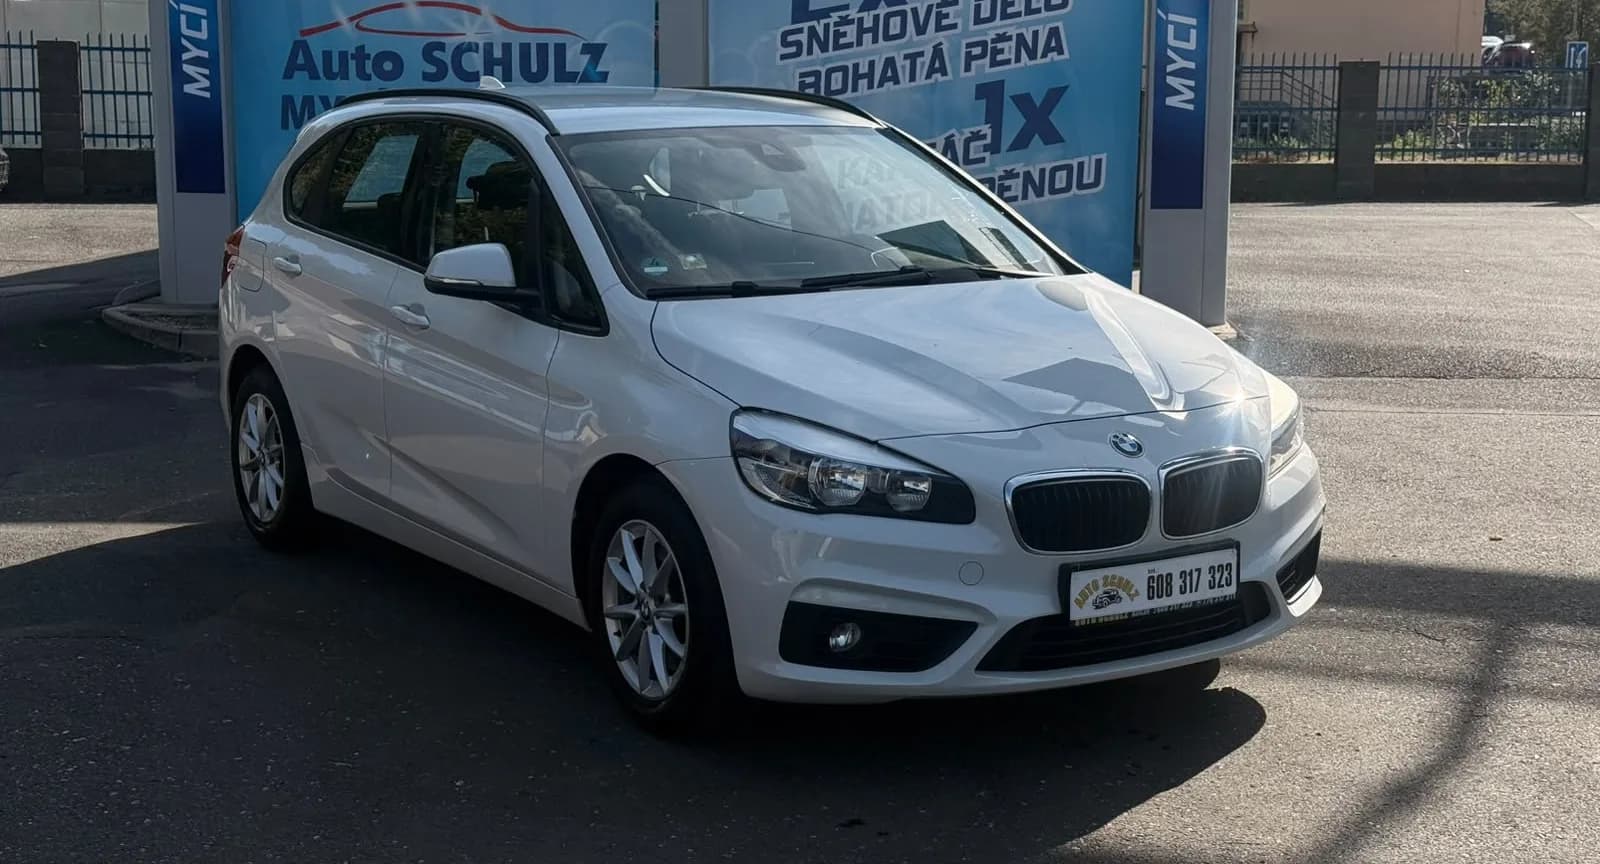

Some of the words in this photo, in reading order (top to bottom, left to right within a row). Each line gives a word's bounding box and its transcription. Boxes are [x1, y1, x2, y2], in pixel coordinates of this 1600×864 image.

[169, 0, 211, 98] MYCÍ
[282, 39, 405, 81] Auto
[422, 41, 609, 83] SCHULZ
[964, 25, 1066, 73] PĚNA
[1157, 8, 1197, 110] MYCÍ
[975, 80, 1071, 156] 1x
[1147, 572, 1173, 600] 608
[1179, 567, 1202, 596] 317
[1208, 562, 1233, 590] 323
